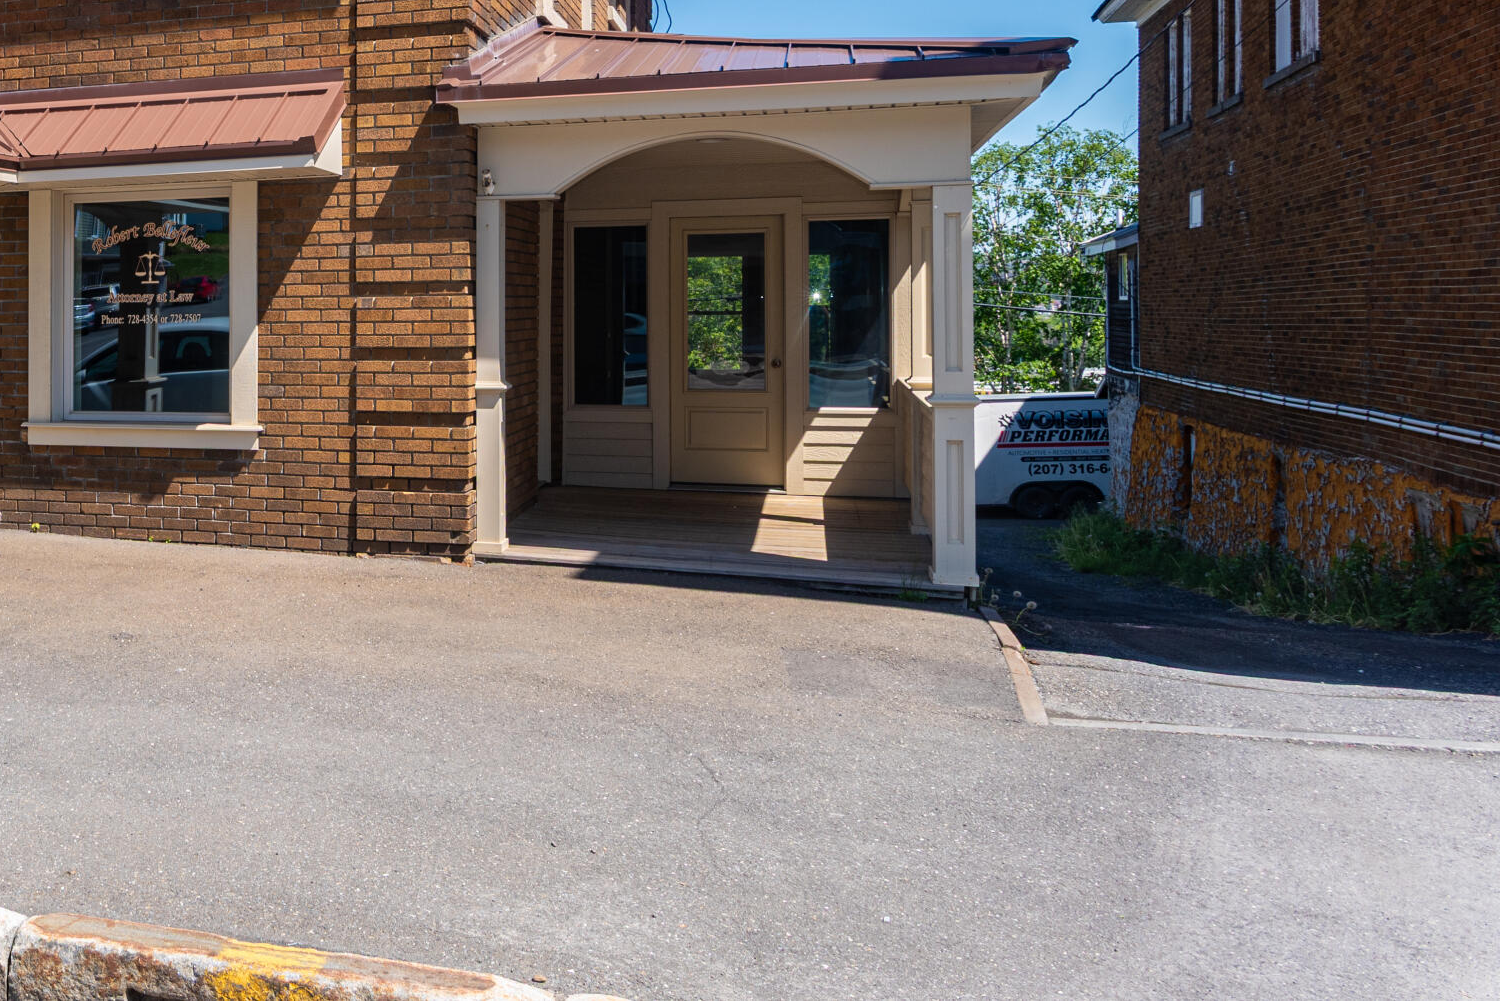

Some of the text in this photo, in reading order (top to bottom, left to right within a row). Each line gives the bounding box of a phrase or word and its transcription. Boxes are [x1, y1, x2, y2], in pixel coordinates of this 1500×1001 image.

[92, 220, 210, 255] Robert Bellefleur
[106, 290, 195, 306] Attorney at Law
[101, 314, 125, 325] Phone:
[127, 314, 158, 325] 728-4354
[1028, 462, 1110, 476] (207) 316-6
